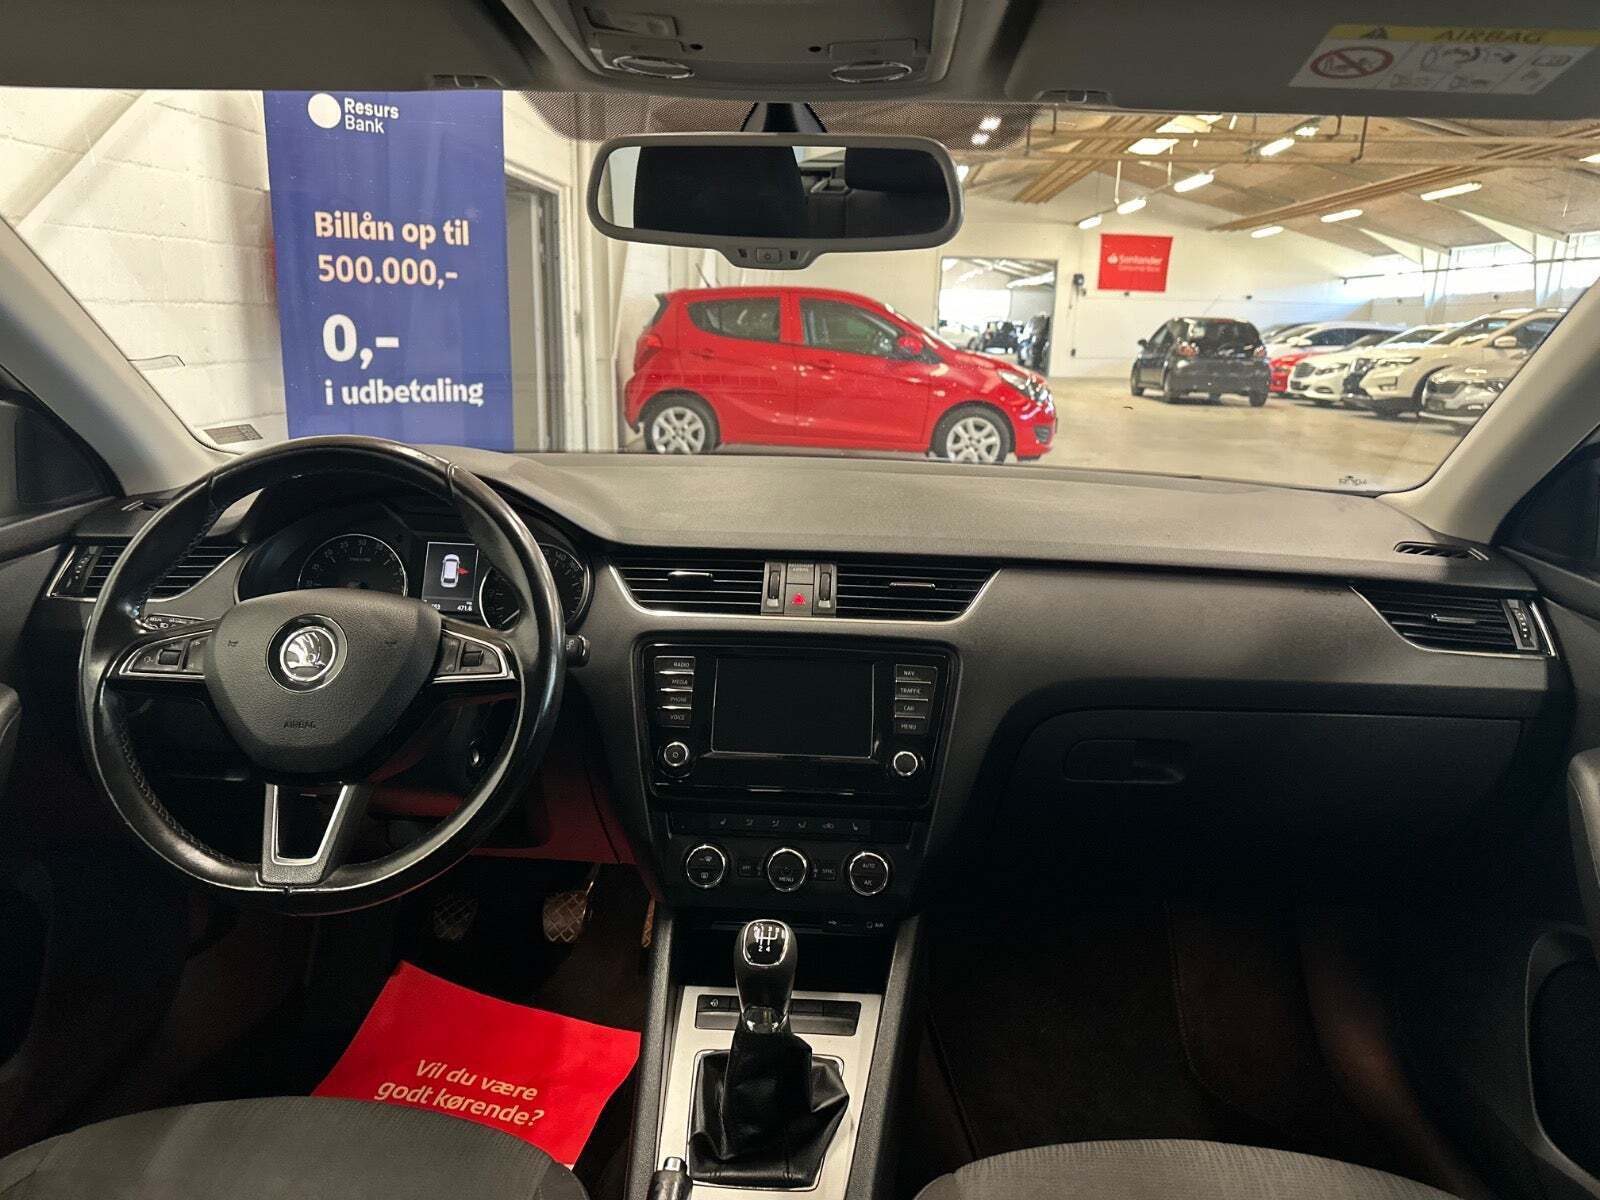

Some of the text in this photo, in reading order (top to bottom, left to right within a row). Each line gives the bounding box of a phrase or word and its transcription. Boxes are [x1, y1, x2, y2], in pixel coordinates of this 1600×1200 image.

[1434, 29, 1542, 43] AIRBAG
[344, 98, 399, 118] Resurs
[345, 114, 385, 134] Bank
[315, 211, 470, 250] Billån op til
[318, 255, 458, 290] 500.000,-
[322, 314, 399, 369] 0,-
[325, 378, 484, 407] i udbetaling
[283, 720, 317, 729] AIRBAG
[416, 1059, 538, 1101] Vil du være
[374, 1081, 545, 1127] godt kørende?
